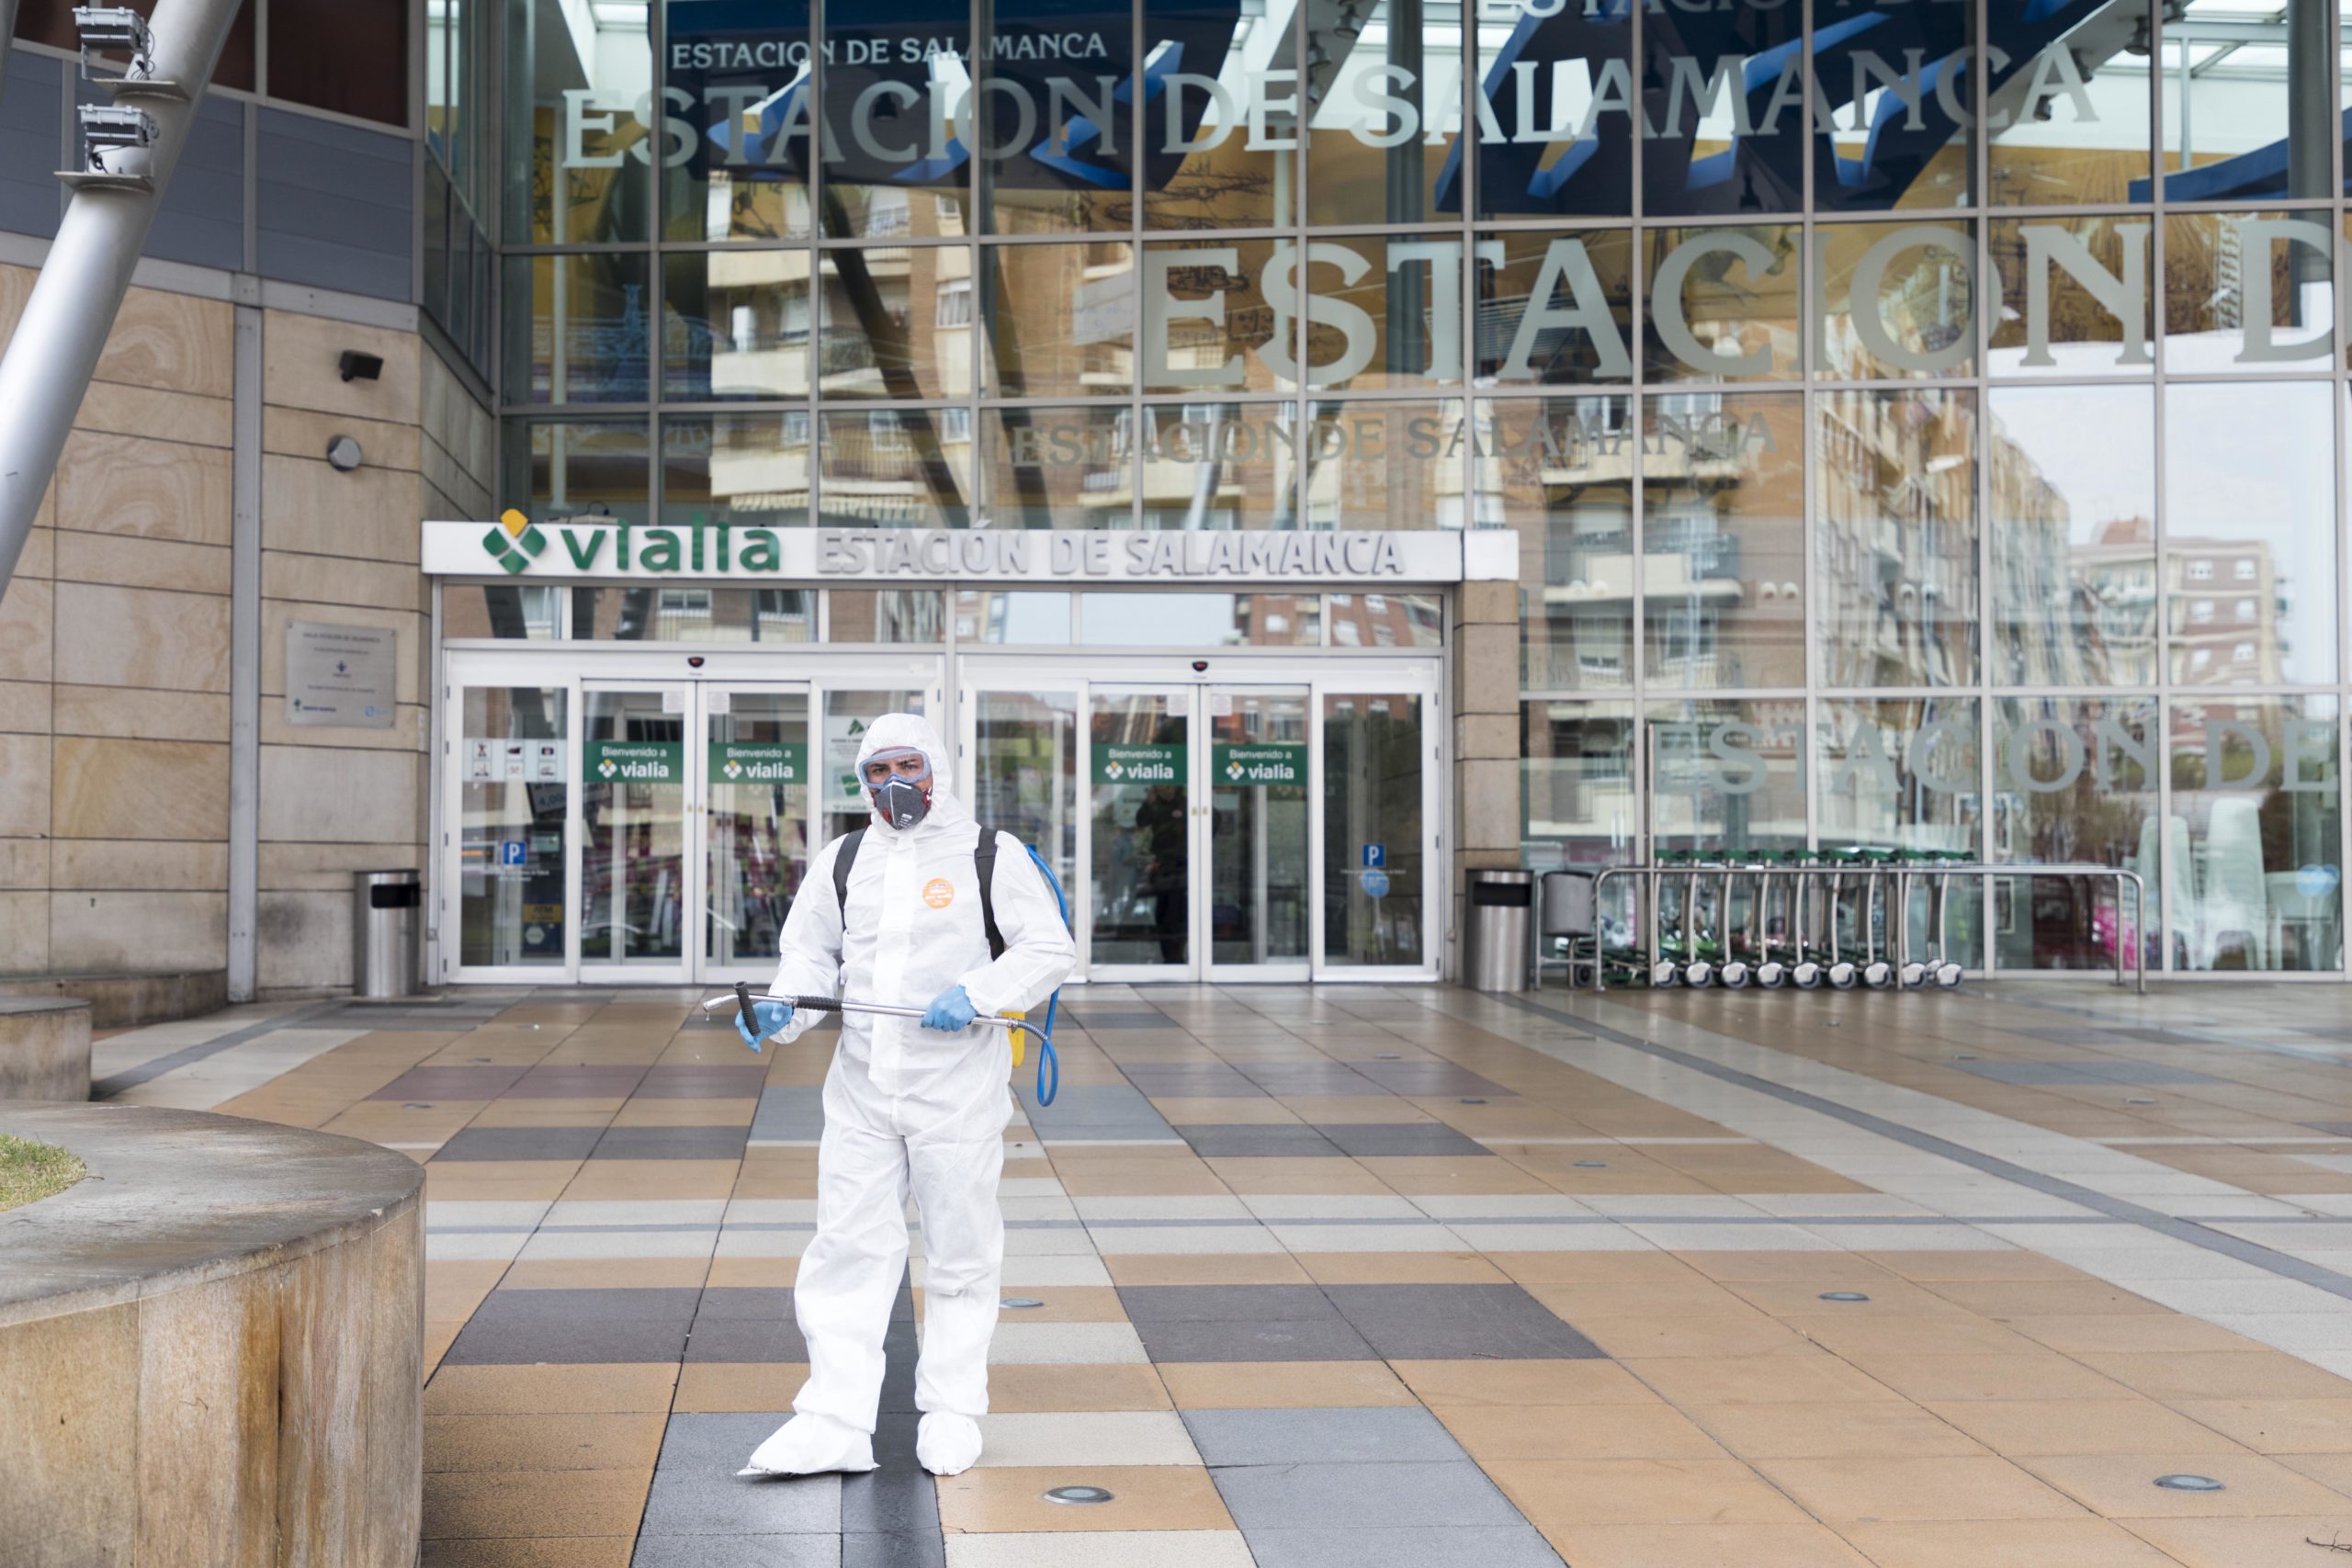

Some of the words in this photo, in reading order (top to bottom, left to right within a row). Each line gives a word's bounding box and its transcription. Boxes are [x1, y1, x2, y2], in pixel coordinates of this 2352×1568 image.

[671, 40, 835, 70] ESTACION
[846, 39, 890, 65] DE
[899, 31, 1108, 62] SALAMANCA
[561, 75, 1118, 169] ESTACION
[1160, 70, 1311, 154] DE
[1349, 41, 2100, 149] SALAMANCA
[1142, 222, 2154, 387] ESTACION
[1012, 418, 1299, 468] ESTACION
[1310, 418, 1385, 460] DE
[1407, 412, 1777, 460] SALAMANCA
[560, 511, 780, 572] vialia
[817, 518, 1029, 575] ESTACIÓN
[1051, 528, 1111, 576] DE
[1125, 529, 1406, 576] SALAMANCA
[601, 746, 658, 758] Bienvenido
[660, 749, 667, 758] a
[726, 747, 782, 759] Bienvenido
[785, 750, 792, 759] a
[1108, 749, 1163, 760] Bienvenido
[1164, 750, 1172, 759] a
[1228, 749, 1283, 760] Bienvenido
[1284, 750, 1293, 760] a
[1654, 718, 2160, 795] ESTACON
[620, 761, 670, 778] vialia
[745, 761, 795, 779] vialia
[1126, 762, 1174, 780] vialia
[1248, 762, 1295, 780] vialia
